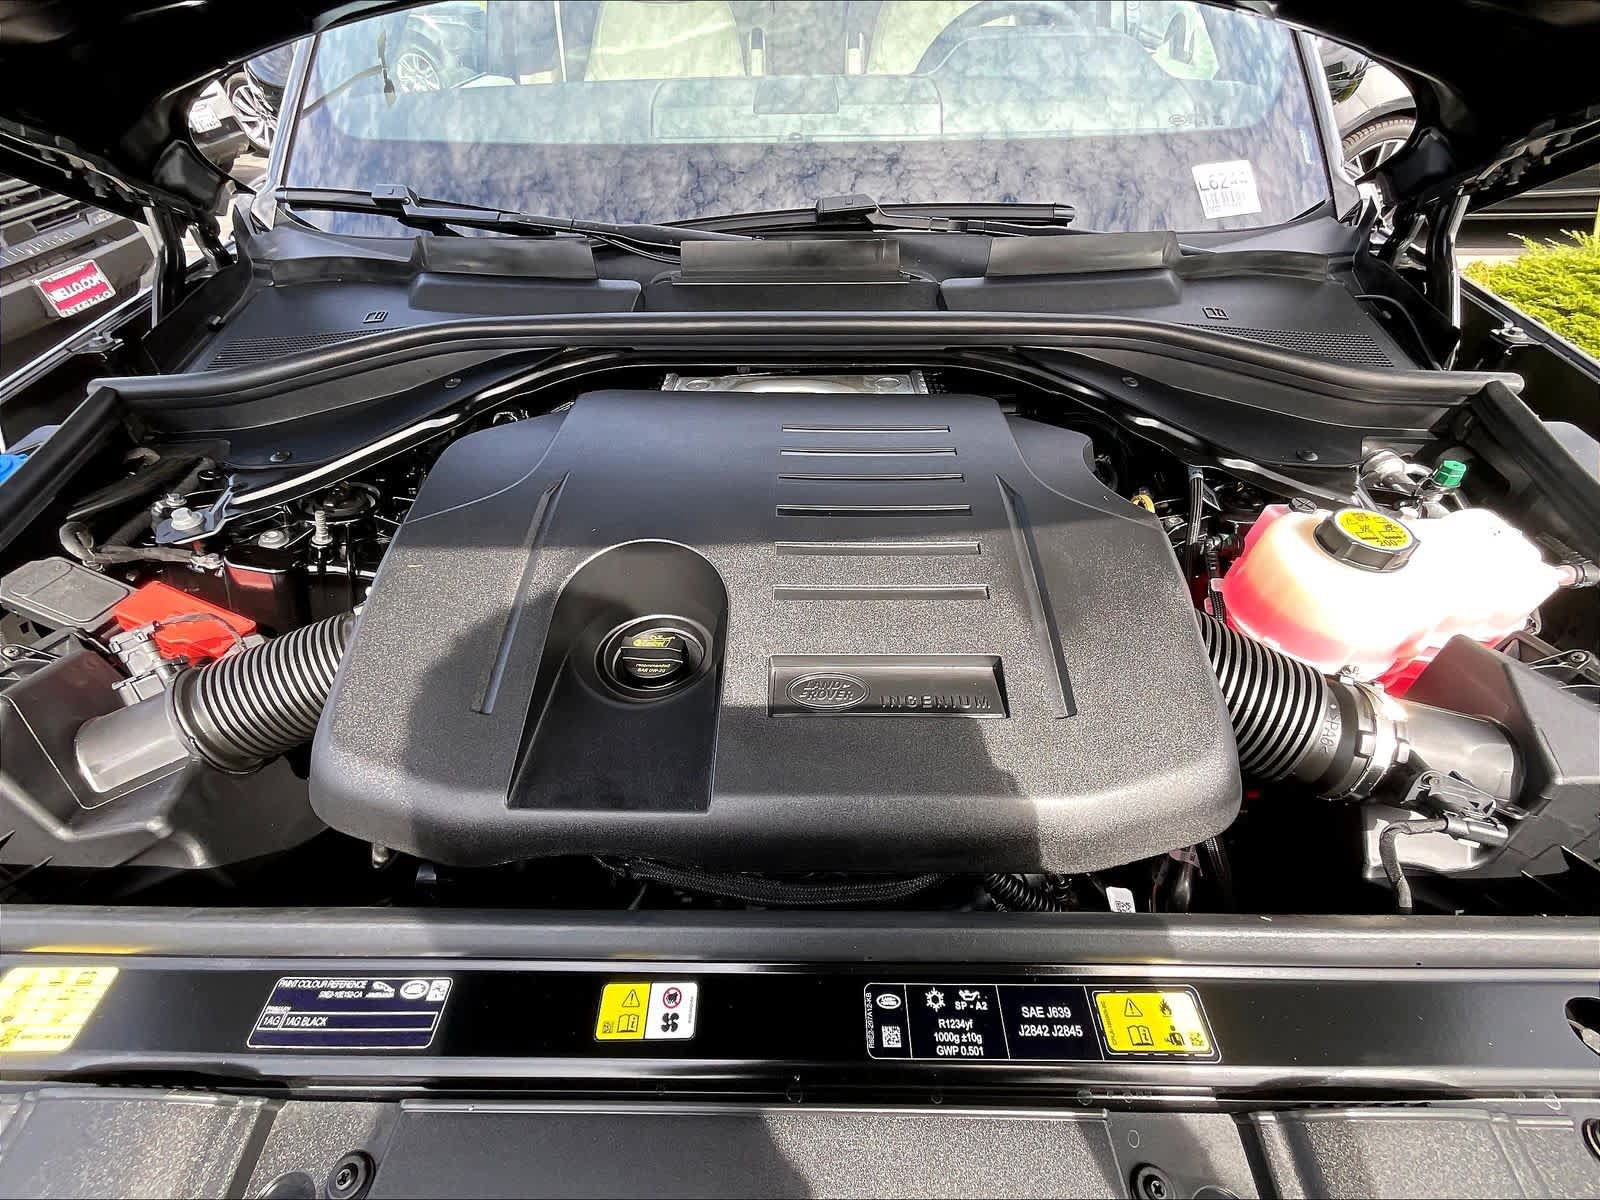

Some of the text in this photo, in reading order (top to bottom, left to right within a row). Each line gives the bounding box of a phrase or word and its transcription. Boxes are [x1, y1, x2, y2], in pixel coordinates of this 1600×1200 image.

[879, 695, 992, 709] INGENIUM
[299, 980, 329, 989] COLOUR
[954, 1001, 968, 1011] SP
[975, 1001, 989, 1011] A2
[1021, 1006, 1072, 1019] SAE J639
[262, 1016, 280, 1026] 1AG
[285, 1016, 328, 1027] 1AG BLACK
[938, 1018, 974, 1031] R1234yf
[1018, 1024, 1084, 1037] J2842 J2845
[933, 1031, 983, 1045] 1000g ±10g
[936, 1045, 984, 1057] GWP 0.501
